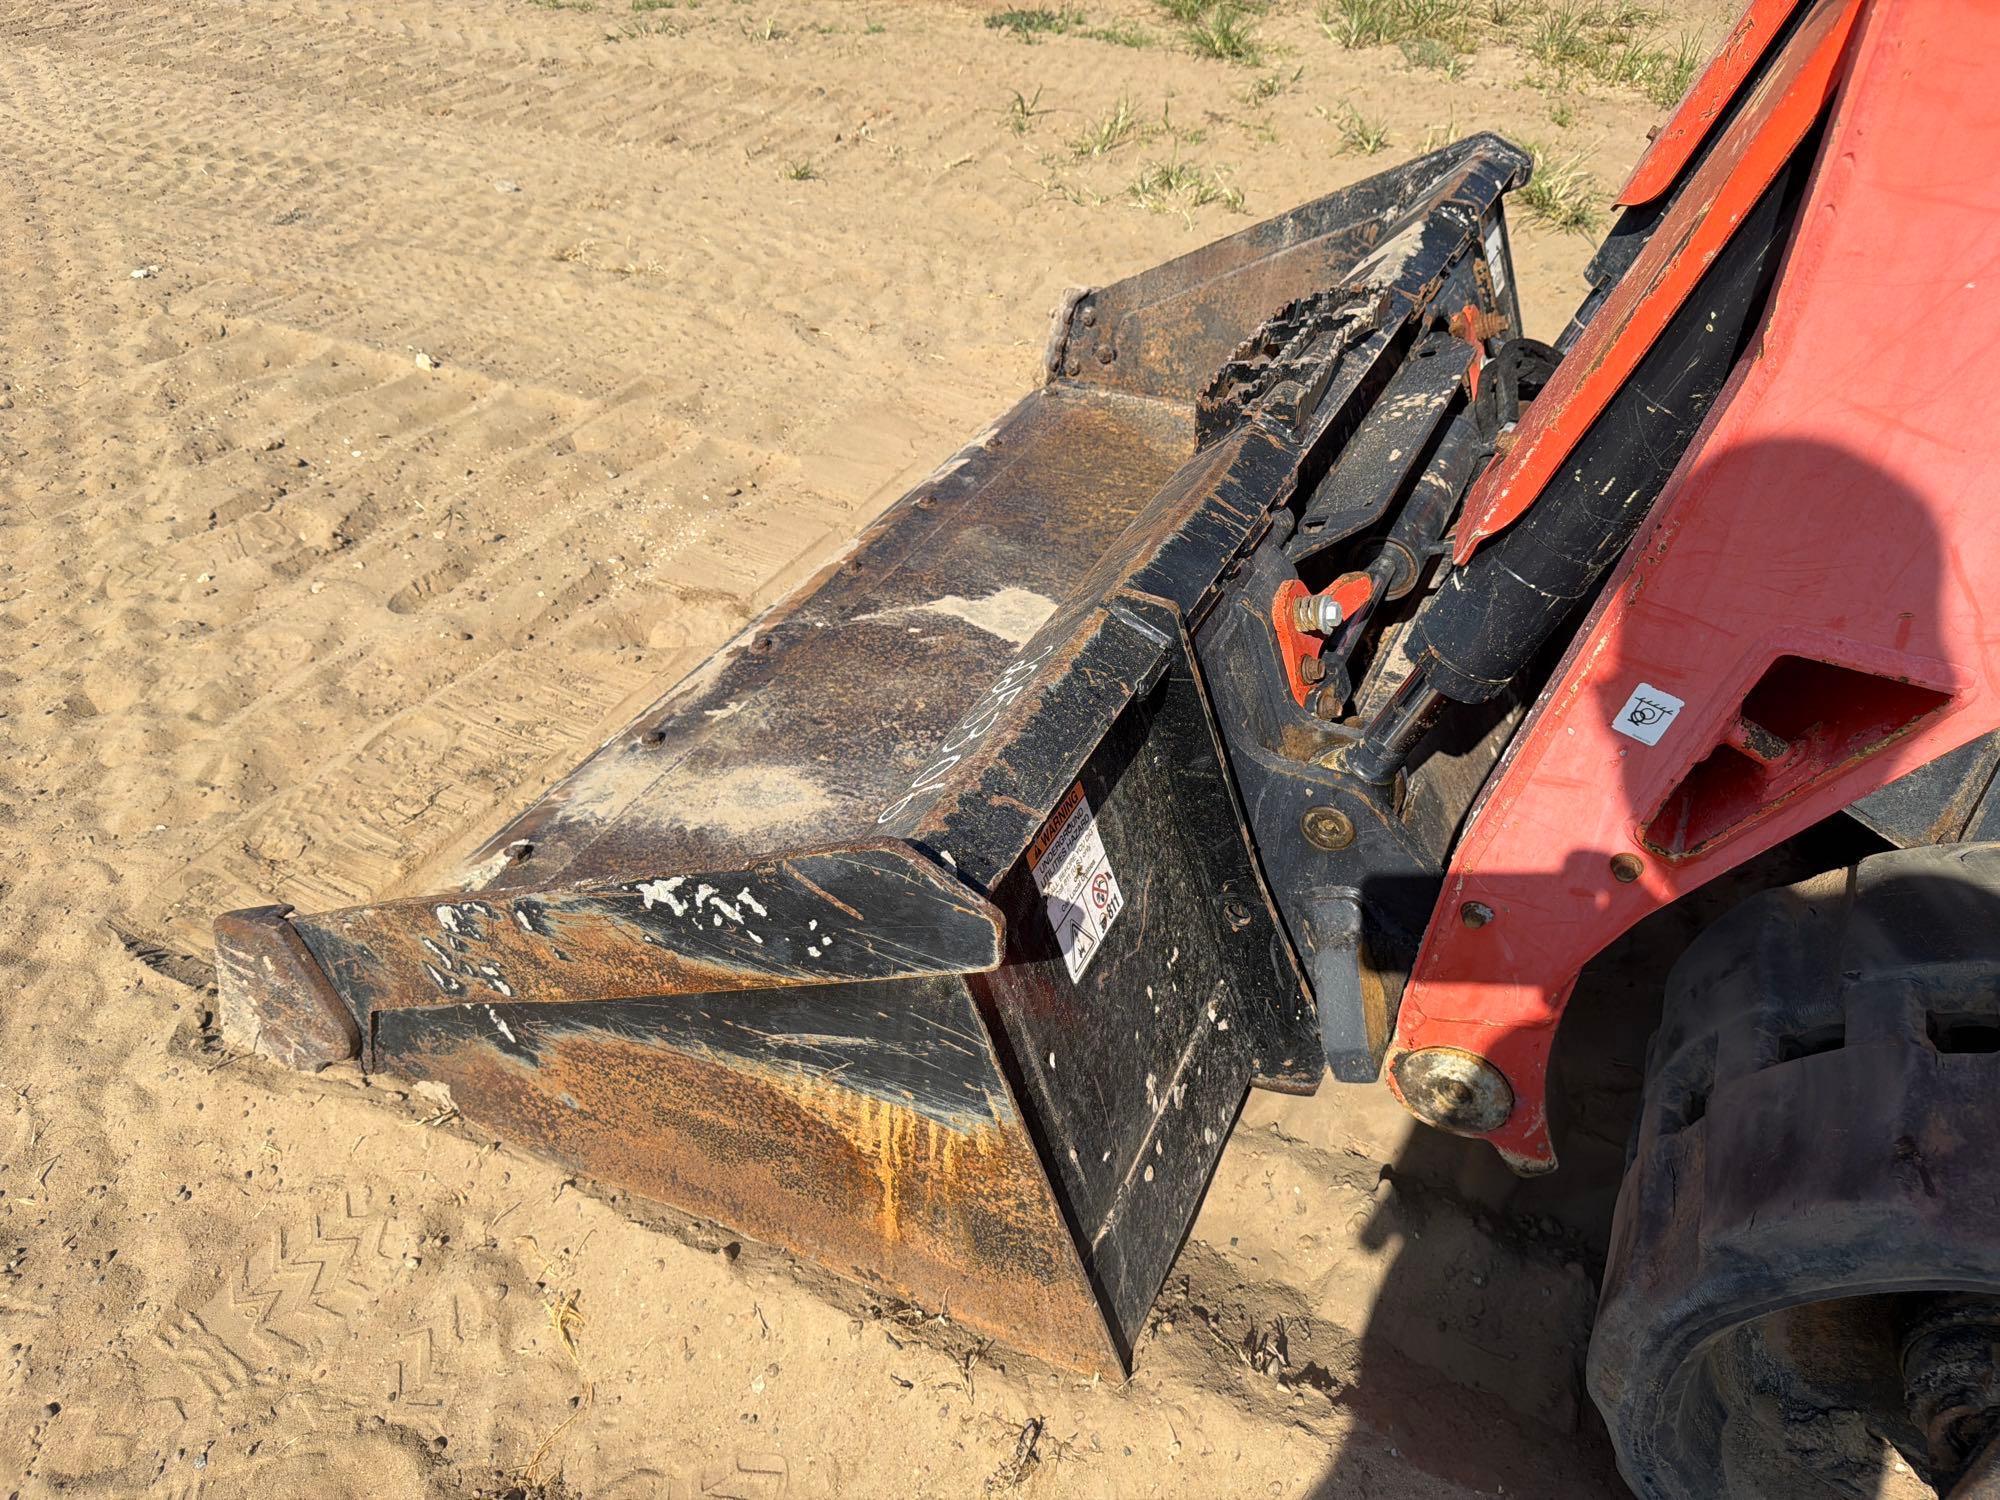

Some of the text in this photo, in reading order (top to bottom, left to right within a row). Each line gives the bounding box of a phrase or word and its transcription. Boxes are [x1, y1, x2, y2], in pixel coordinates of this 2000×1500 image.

[1038, 805, 1083, 874] UNDERGROUND
[1040, 788, 1079, 848] WARNING
[1040, 812, 1089, 889] UTILITIES HAZARD
[1105, 892, 1119, 920] 811
